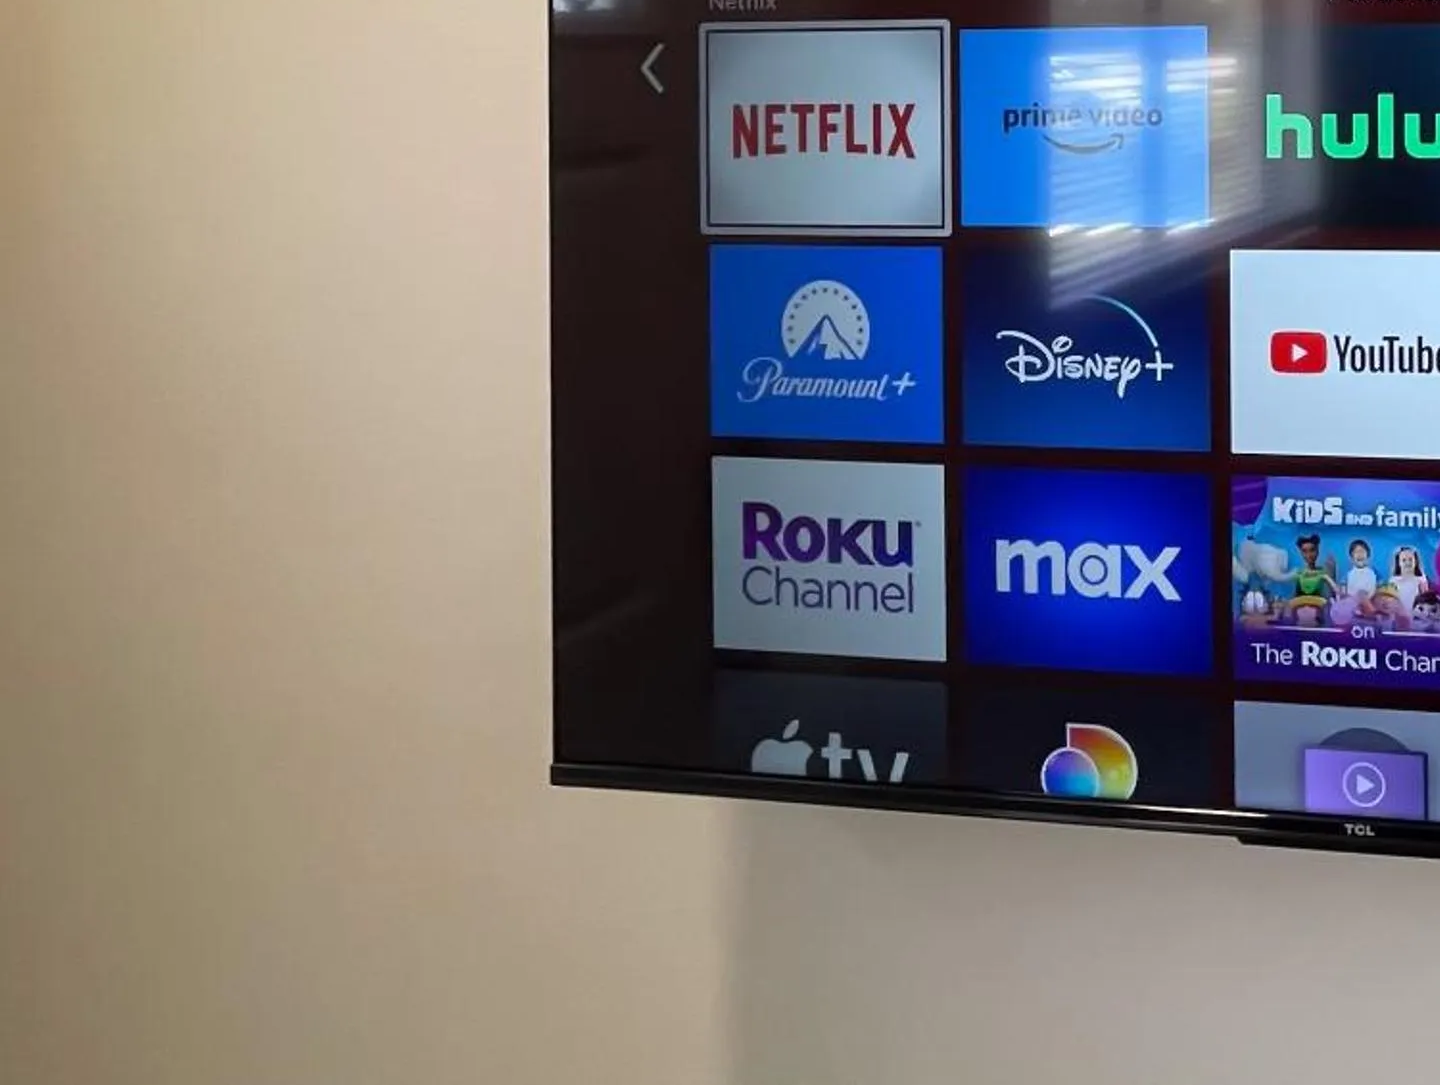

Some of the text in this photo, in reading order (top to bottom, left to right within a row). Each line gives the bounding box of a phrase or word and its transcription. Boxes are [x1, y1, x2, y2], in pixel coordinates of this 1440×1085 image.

[731, 102, 917, 160] NETFLIX
[1002, 102, 1164, 134] prime video
[736, 356, 917, 403] Paramount+
[996, 330, 1174, 399] Disney+
[741, 501, 914, 567] Roku
[741, 565, 915, 614] Channel
[995, 538, 1183, 603] max
[1250, 642, 1294, 666] The
[1301, 640, 1378, 670] Roku
[1350, 624, 1376, 640] on
[1343, 823, 1376, 837] TCL
